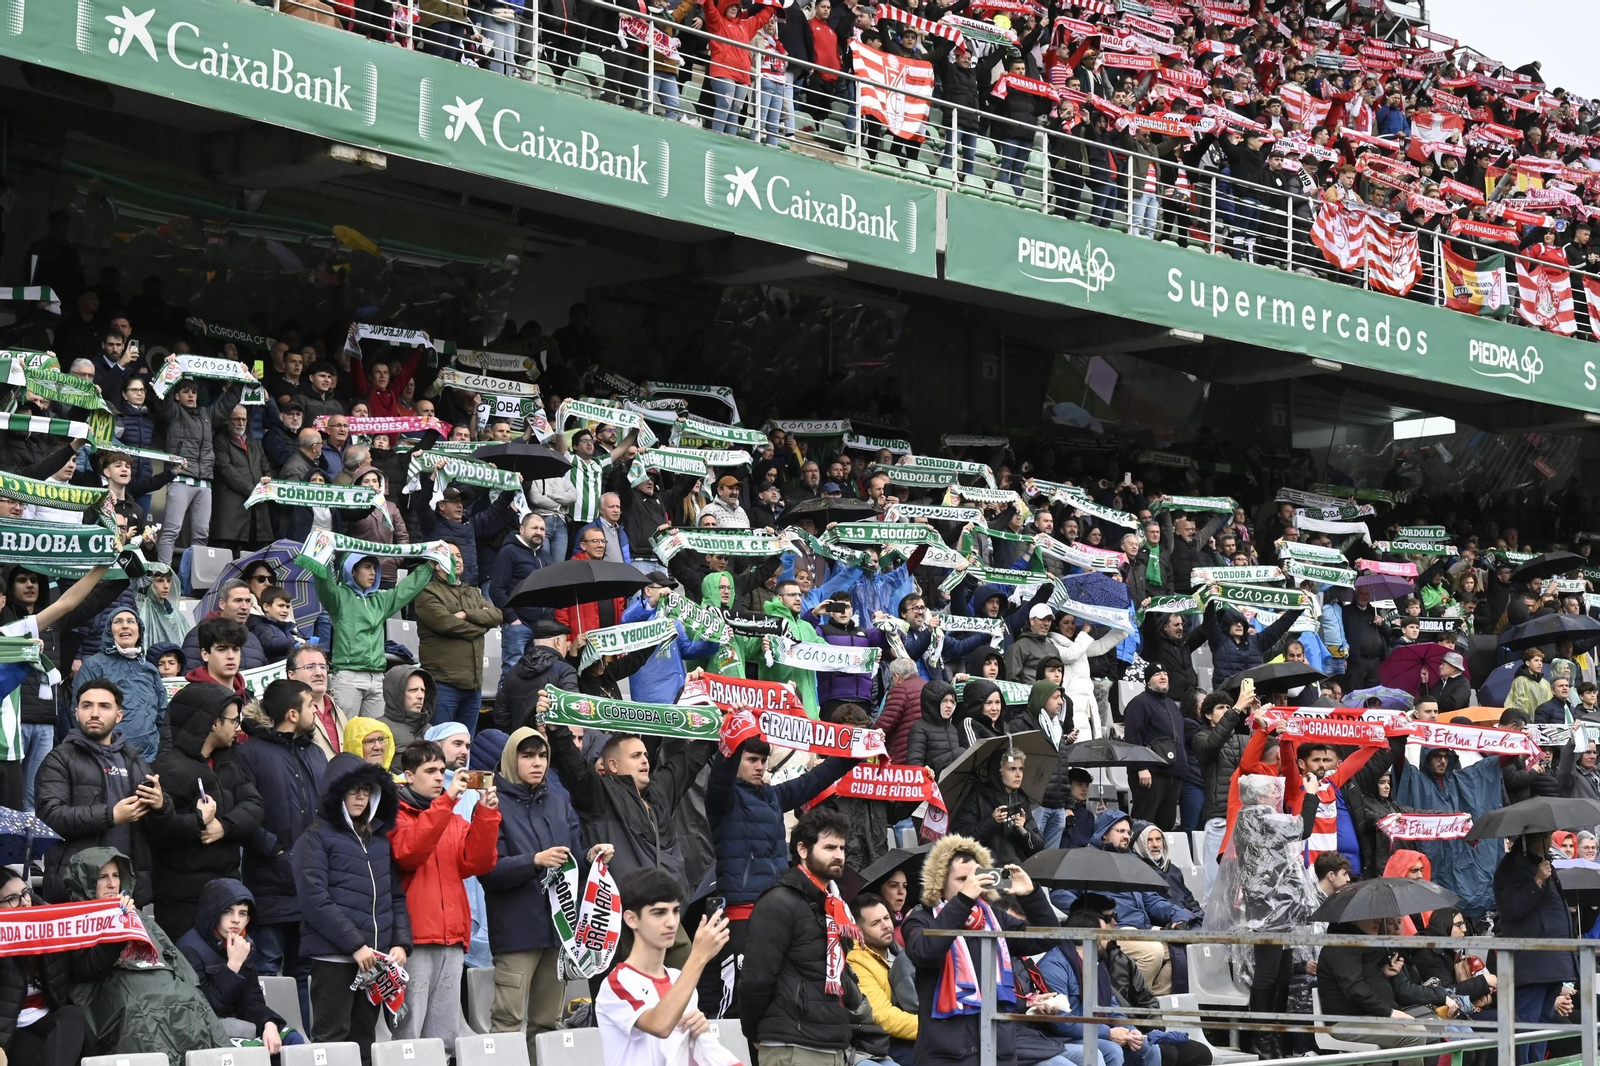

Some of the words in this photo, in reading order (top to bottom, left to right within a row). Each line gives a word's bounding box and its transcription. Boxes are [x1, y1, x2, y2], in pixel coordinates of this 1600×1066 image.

[1211, 10, 1235, 23] GRANADA
[1102, 34, 1123, 46] NADA
[167, 21, 353, 111] CaixaBank
[1008, 75, 1038, 91] GRANADA
[1134, 117, 1168, 131] GRANADA
[1169, 124, 1183, 134] C.F.
[492, 108, 649, 185] CaixaBank
[1275, 139, 1295, 149] TERNA
[1310, 147, 1332, 158] LUCHA
[766, 175, 899, 242] CaixaBank
[1167, 267, 1428, 356] Supermercados
[208, 324, 253, 343] CÓRDOBA
[254, 336, 265, 346] CF
[187, 358, 238, 374] CÓRDOBA
[464, 375, 522, 393] CÓRDOBA
[348, 421, 411, 433] ORDOBESA
[781, 420, 839, 431] CÓRDOBA
[681, 437, 707, 447] DOBA
[888, 467, 937, 483] CÓRDOBA
[939, 473, 953, 484] CF
[276, 485, 346, 504] CÓRDOBA
[2, 532, 82, 554] RDOBA
[687, 535, 745, 551] CÓRDOBA
[750, 540, 772, 551] C.F.
[1434, 544, 1445, 552] CF
[902, 545, 958, 564] CDOBA
[1255, 569, 1270, 579] C.F.
[1227, 587, 1289, 605] CÓRDOBA
[1419, 620, 1444, 631] RDOBA
[1446, 621, 1455, 631] CF
[597, 634, 618, 647] C.F.
[796, 647, 851, 666] CÓRDOBA
[709, 680, 765, 710] GRANADA
[766, 689, 791, 710] C.F.
[603, 704, 661, 724] CÓRDOBA
[664, 713, 680, 725] CF
[1308, 721, 1366, 738] GRANADACF
[1434, 727, 1473, 747] Eterna
[1476, 729, 1518, 749] Lucha
[852, 765, 925, 784] GRANADA
[851, 781, 874, 795] CLUB
[876, 783, 887, 796] DE
[889, 782, 925, 798] FÚTBOL
[1408, 819, 1434, 837] Eterna
[1435, 817, 1461, 838] Lucha
[585, 878, 613, 953] GRANADA
[25, 922, 54, 939] CLUB
[58, 921, 72, 937] DE
[75, 914, 116, 936] FÚTBOL
[404, 1047, 413, 1055] 25
[485, 1042, 494, 1050] 23
[316, 1053, 326, 1062] 27
